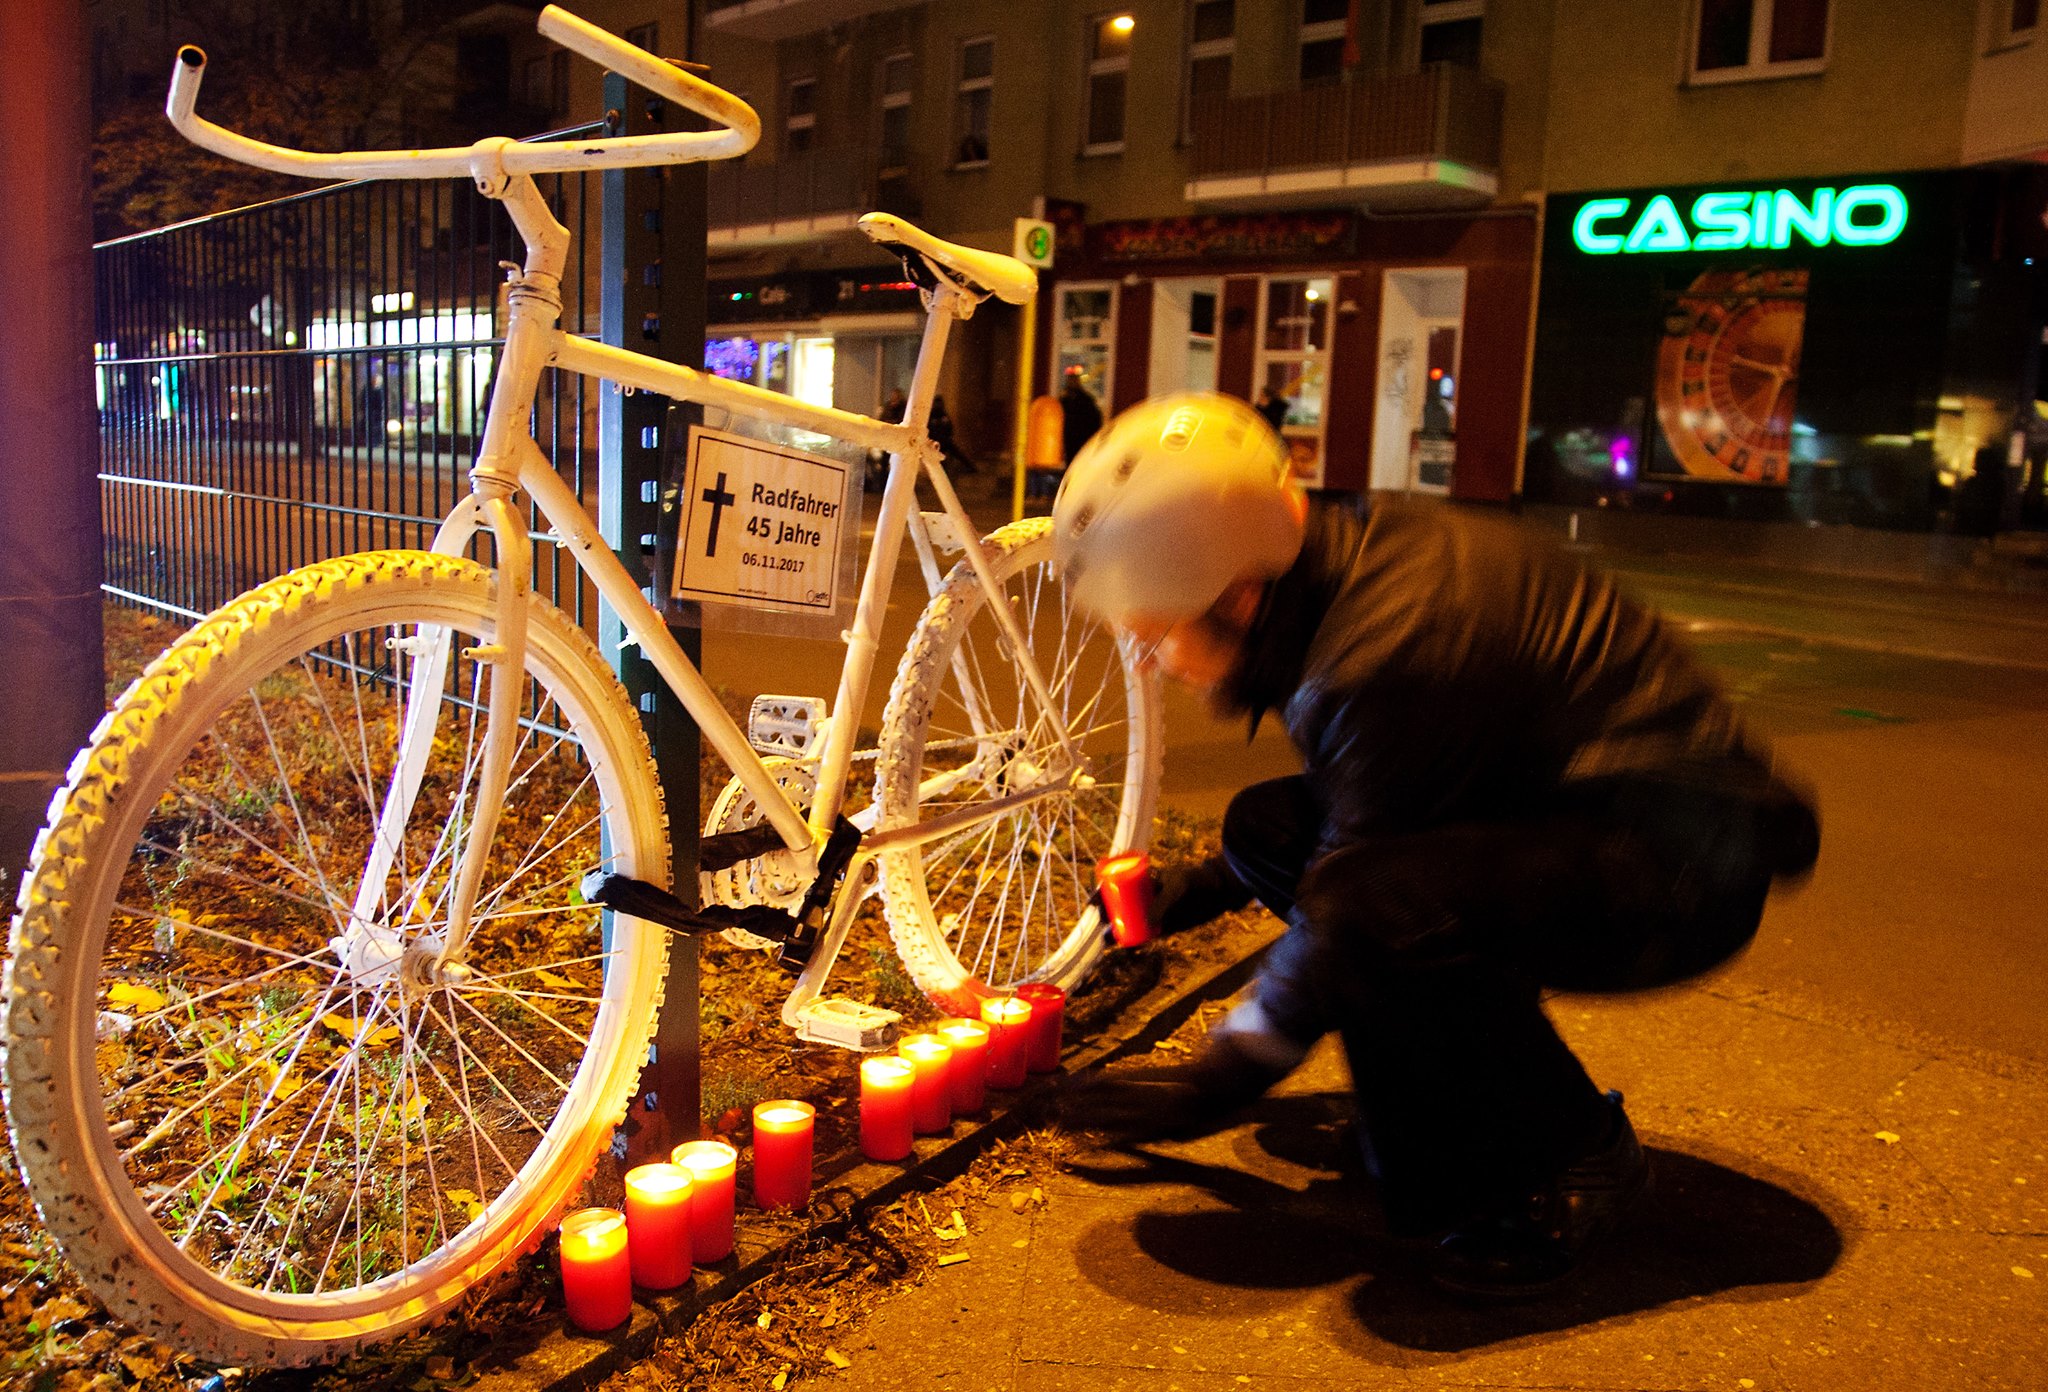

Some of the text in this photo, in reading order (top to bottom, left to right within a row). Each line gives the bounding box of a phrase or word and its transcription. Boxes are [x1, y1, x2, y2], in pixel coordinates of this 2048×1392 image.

[1574, 184, 1908, 254] CASINO
[752, 483, 838, 518] Radfahrer
[747, 516, 821, 547] 45 Jahre
[742, 552, 804, 573] 06.11.2017
